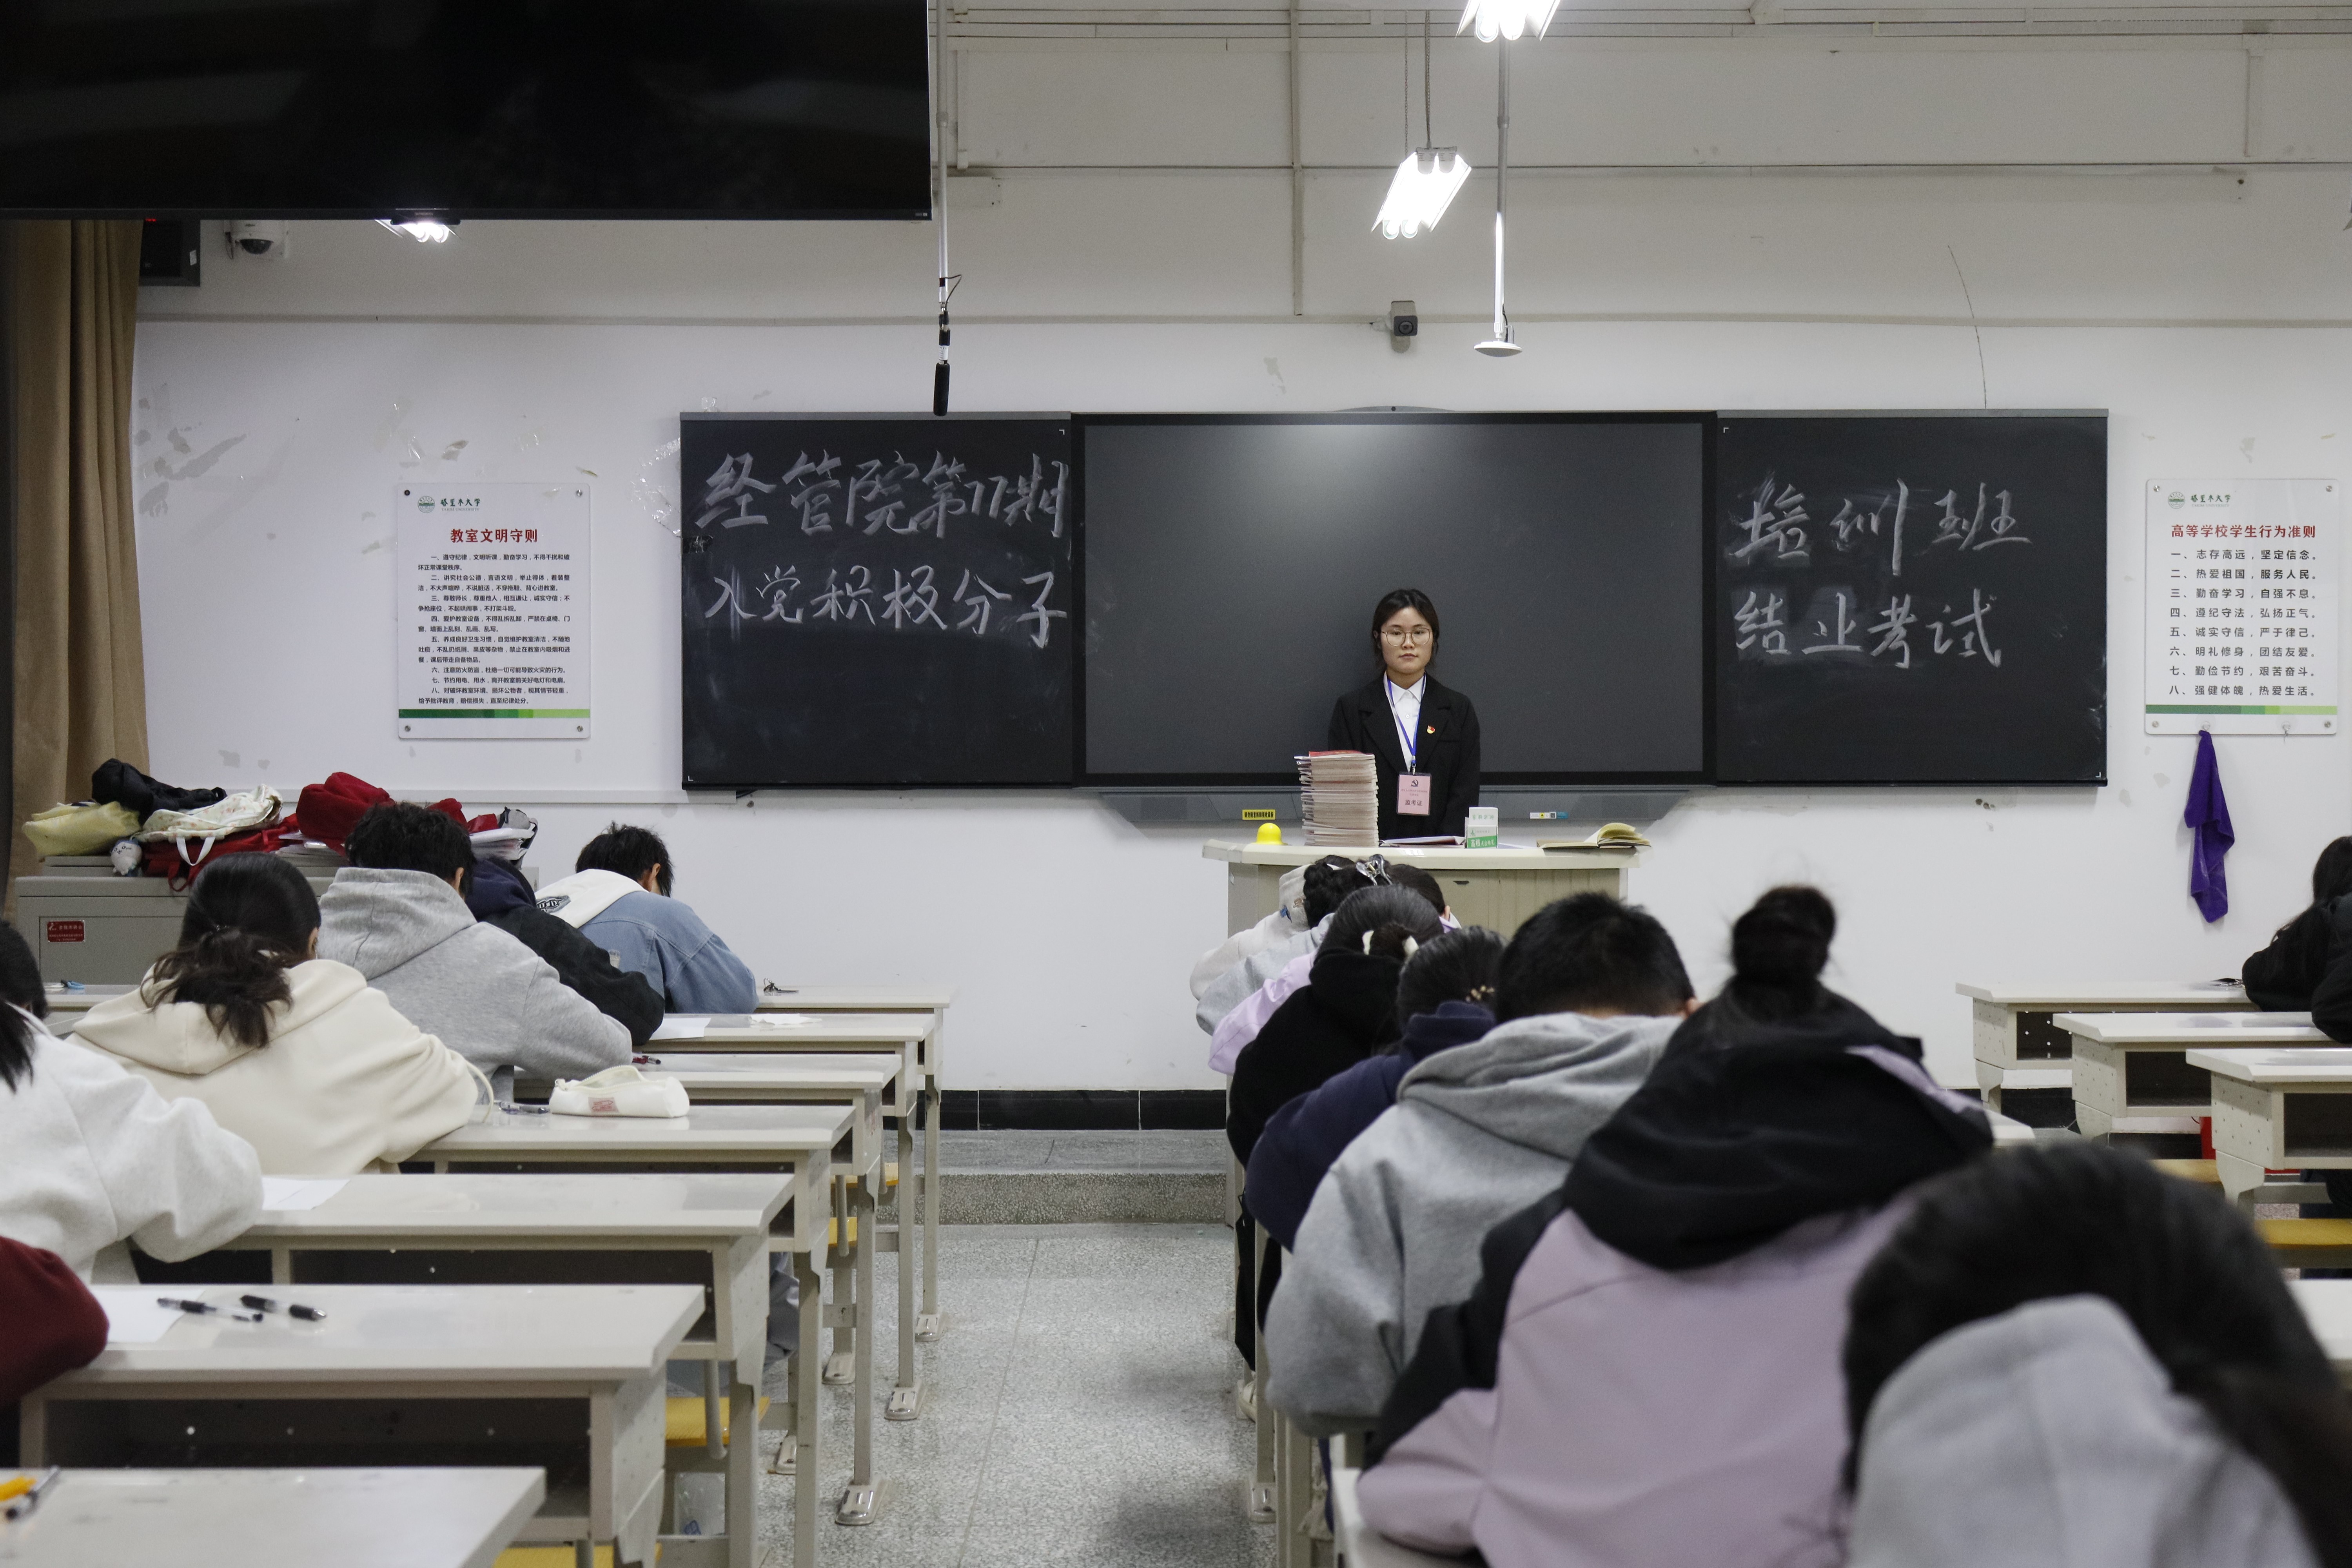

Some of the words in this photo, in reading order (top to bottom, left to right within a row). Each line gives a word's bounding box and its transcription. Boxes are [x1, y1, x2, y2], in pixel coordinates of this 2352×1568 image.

[440, 498, 481, 507] 塔里木大学
[2190, 494, 2231, 503] 塔里木大学
[450, 529, 538, 543] 教室文明守则
[2171, 524, 2316, 539] 高等学校学生行为准则
[2171, 549, 2316, 561] 一、志存高远，坚定信念。
[2171, 569, 2316, 580] 二、热爱祖国，服务人民。
[2171, 588, 2316, 599] 三、勤奋学习，自强不息。
[706, 565, 1069, 650] 入党积极分子
[2170, 608, 2315, 619] 四、遵纪守法，弘扬正气。
[1734, 588, 2002, 669] 结业考试
[2170, 627, 2315, 638] 五、诚实守信，严于律己。
[2170, 646, 2315, 657] 六、明礼修身，团结友爱。
[2169, 666, 2314, 677] 七、勤俭节约，艰苦奋斗。
[2169, 686, 2314, 697] 八、强健体魄，热爱生活。
